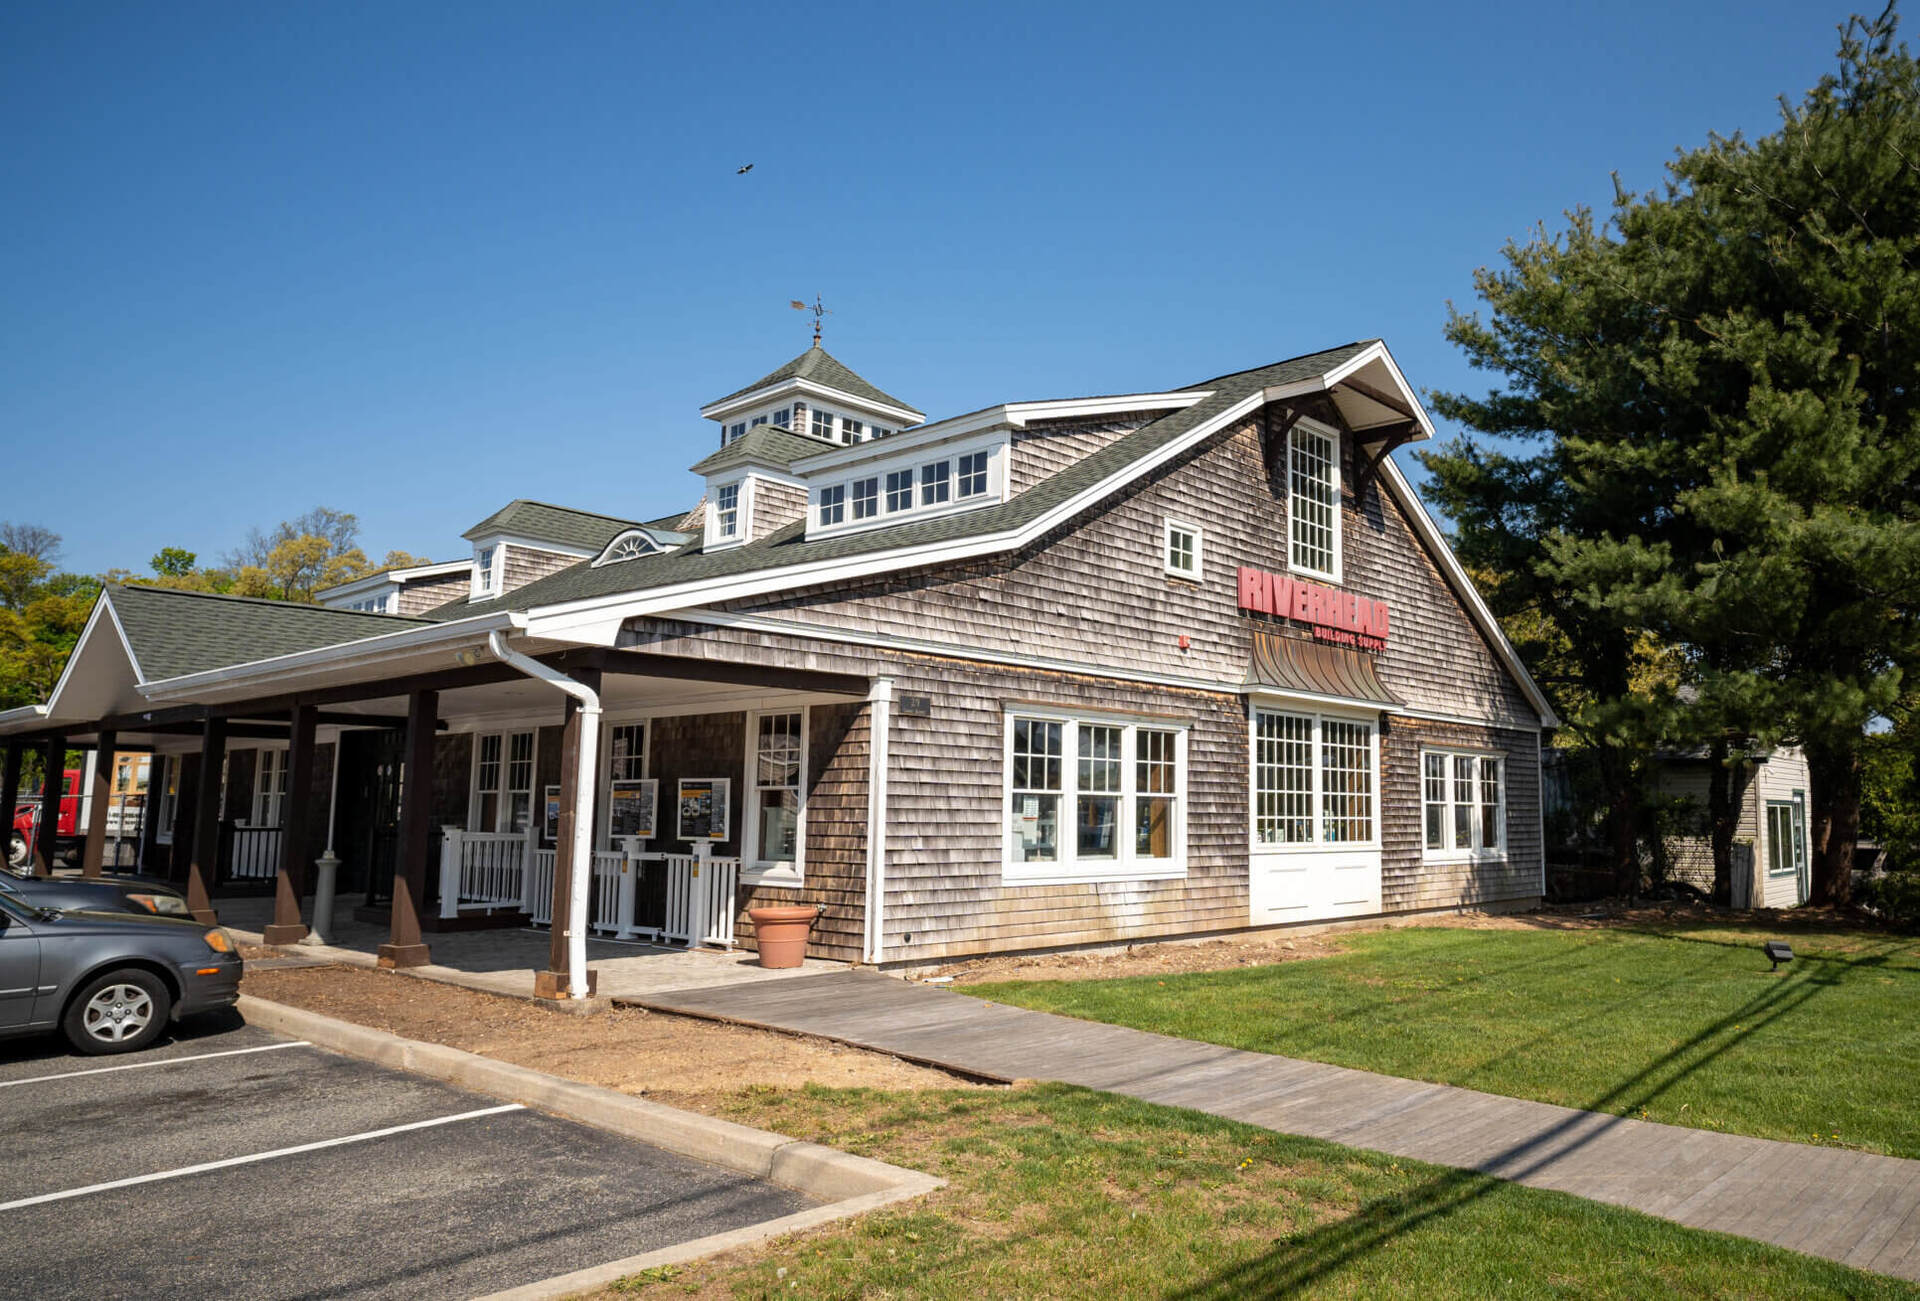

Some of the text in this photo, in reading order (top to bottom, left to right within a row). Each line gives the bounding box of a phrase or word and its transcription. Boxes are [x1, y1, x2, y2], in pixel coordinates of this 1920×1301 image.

[1237, 566, 1389, 639] RIVERHEAD
[1313, 626, 1387, 652] BUILDING SUPPLY
